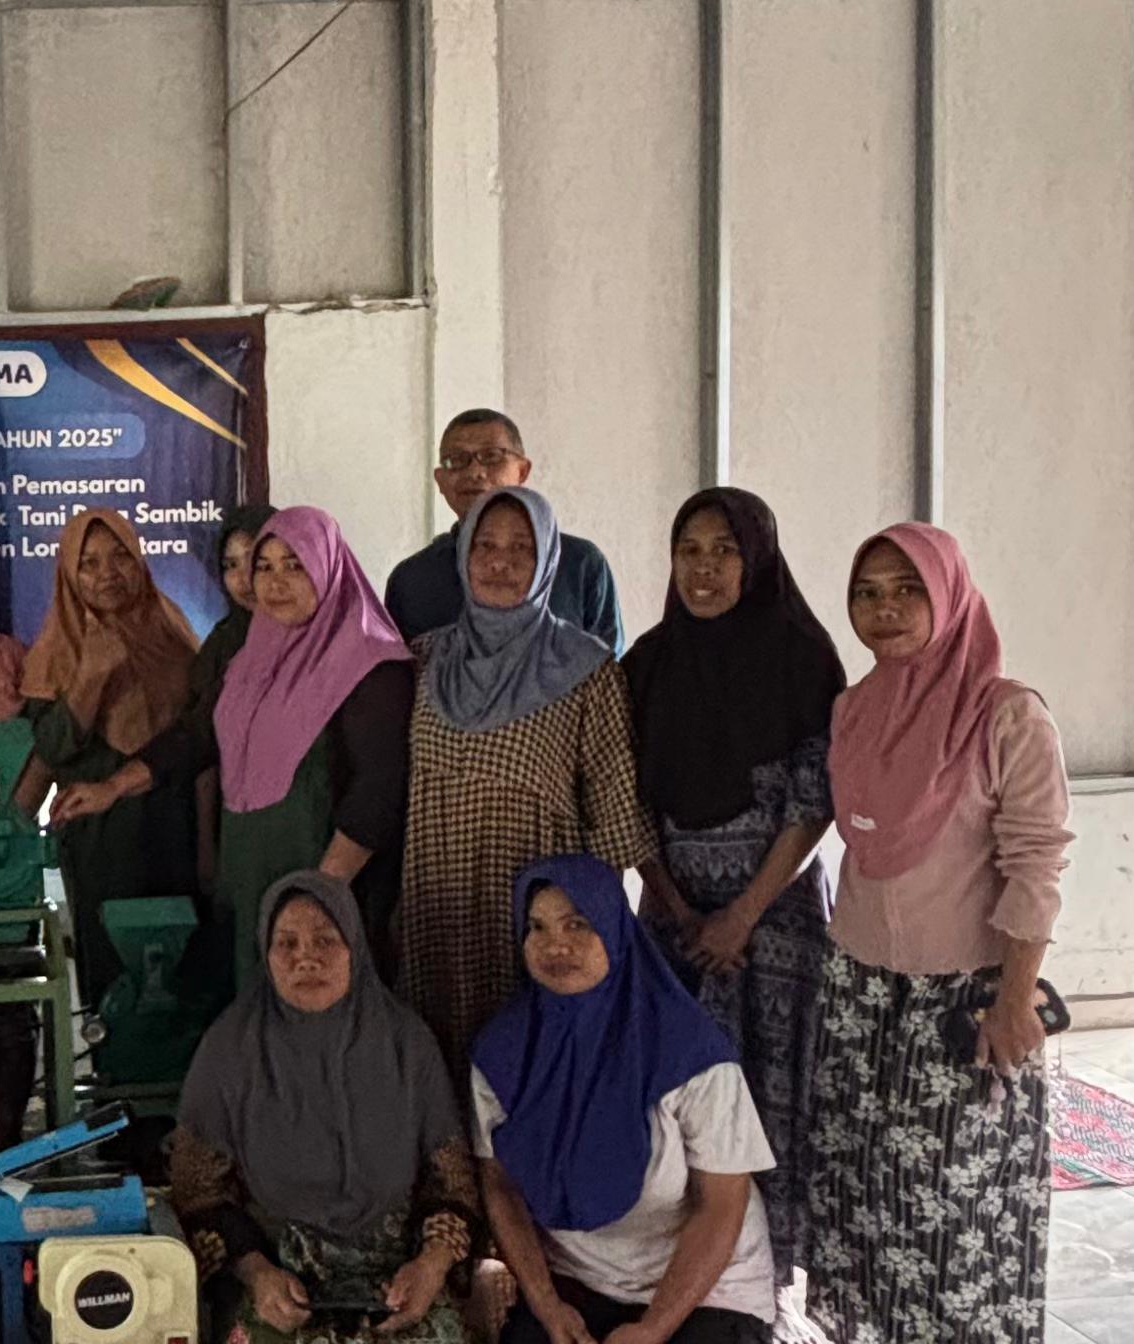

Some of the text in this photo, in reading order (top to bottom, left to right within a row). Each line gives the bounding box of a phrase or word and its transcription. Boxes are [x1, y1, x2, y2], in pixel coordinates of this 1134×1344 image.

[57, 428, 123, 448] 2025"
[12, 474, 146, 496] Pemasaran
[18, 504, 66, 526] Tani
[134, 500, 224, 524] Sambik
[139, 537, 188, 556] tara
[77, 1291, 131, 1308] WILLMAN
